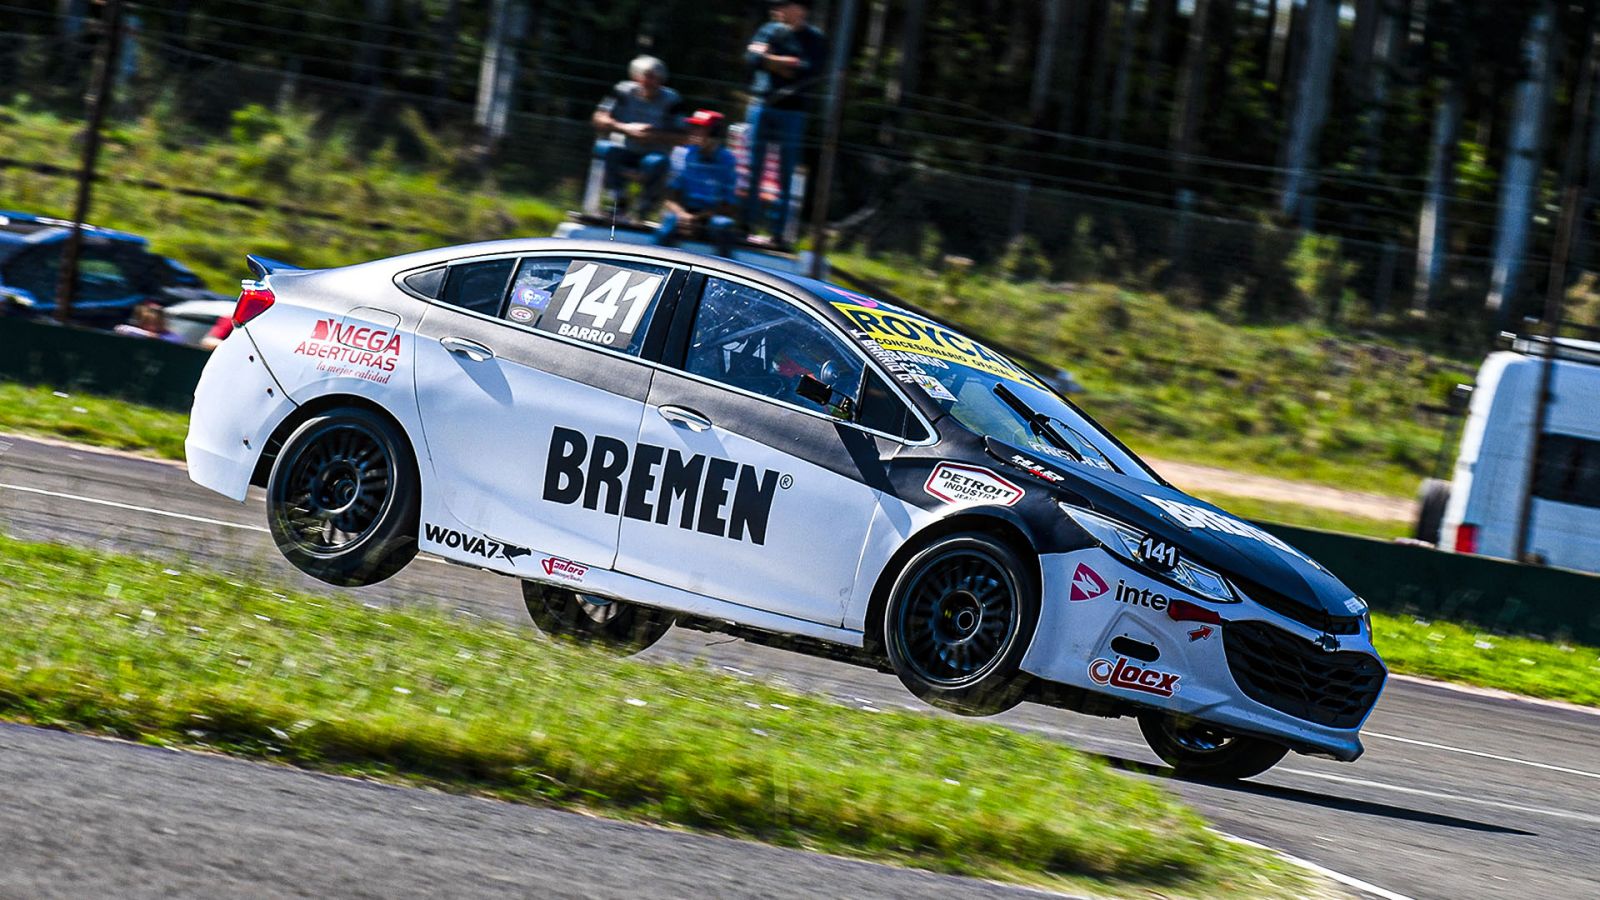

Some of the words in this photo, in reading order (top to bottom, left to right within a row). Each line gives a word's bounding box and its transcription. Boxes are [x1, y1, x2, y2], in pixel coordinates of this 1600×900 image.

[557, 262, 664, 335] 141
[558, 323, 615, 346] BARRIO
[294, 341, 397, 372] ABERTURAS
[874, 337, 967, 363] CONCESIONARIO
[355, 369, 391, 384] calidad
[542, 425, 780, 546] BREMEN
[939, 470, 1014, 498] DETROIT
[944, 481, 998, 500] INDUSTRY
[1142, 538, 1176, 567] 141
